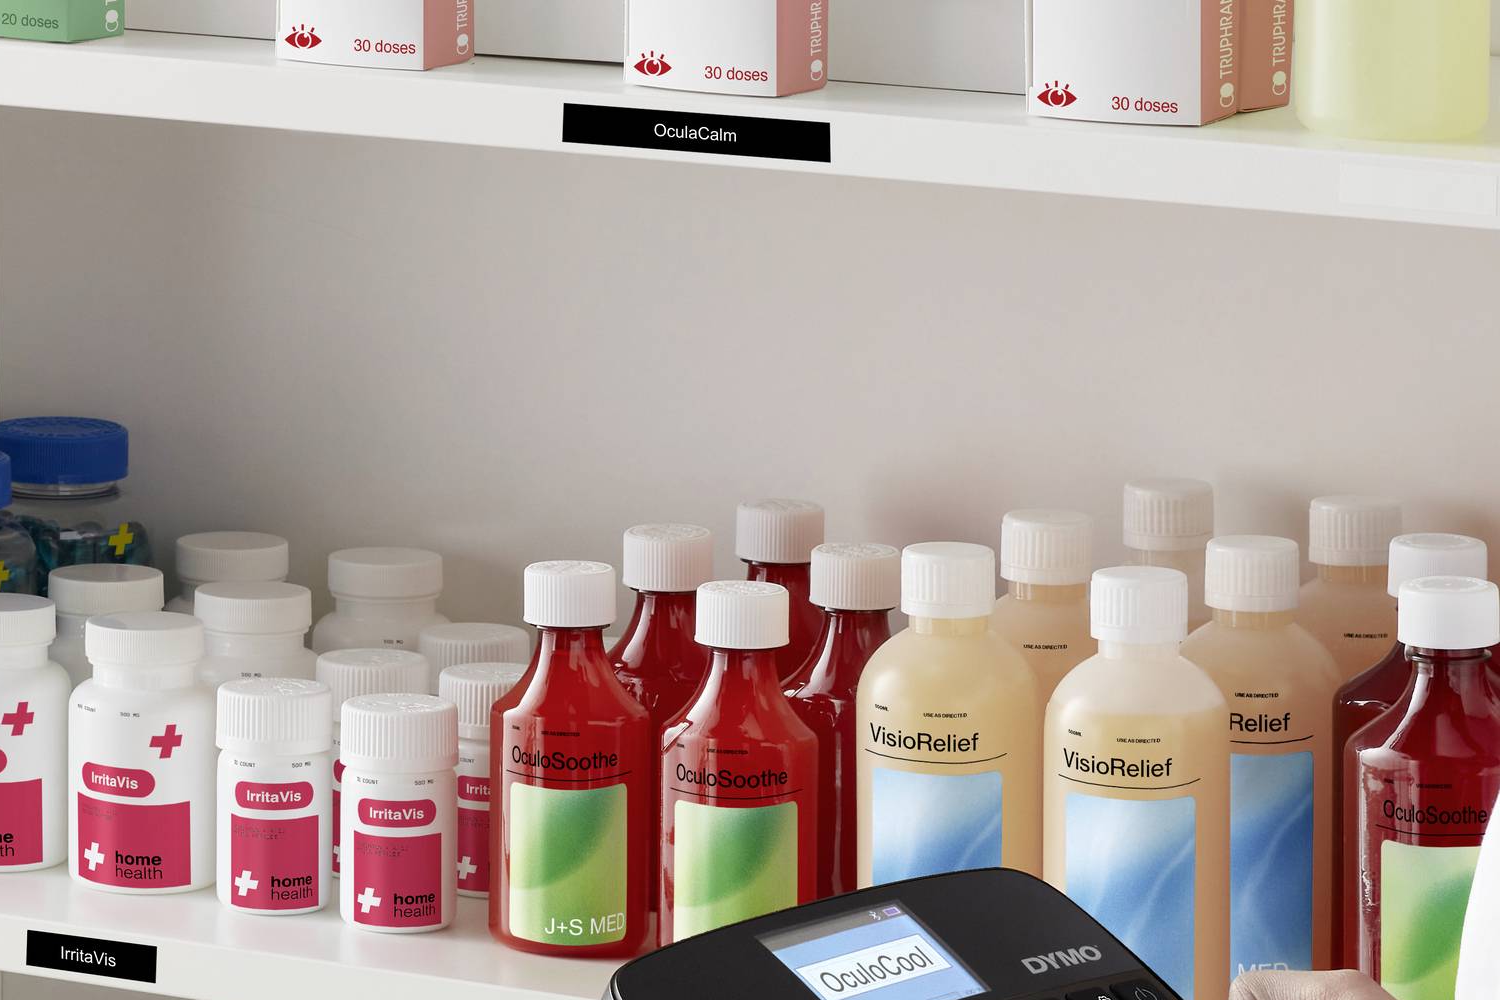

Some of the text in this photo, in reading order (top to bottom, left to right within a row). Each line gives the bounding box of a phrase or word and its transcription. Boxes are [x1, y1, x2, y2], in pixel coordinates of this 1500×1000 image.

[0, 12, 60, 30] 20 doses
[353, 38, 416, 56] 30 doses
[704, 65, 768, 83] 30 doses
[1111, 96, 1179, 115] 30 doses
[653, 123, 737, 143] OculaCalm
[870, 722, 979, 753] VisioRelief
[511, 745, 618, 771] OculoSoothe
[1063, 747, 1172, 778] VisioRelief
[91, 771, 139, 790] IrritaVis
[676, 763, 788, 789] OculoSoothe
[246, 789, 302, 804] IrritaVis
[369, 806, 425, 821] IrritaVis
[1382, 799, 1488, 826] OculoSoothe
[114, 850, 163, 867] home
[114, 864, 164, 880] health
[270, 874, 313, 889] home
[270, 887, 314, 901] health
[393, 892, 436, 906] home
[393, 904, 437, 919] health
[544, 912, 625, 936] J+S MED
[59, 945, 117, 968] IrritaVis
[1020, 944, 1103, 976] DYMO
[819, 945, 934, 993] OculoCool
